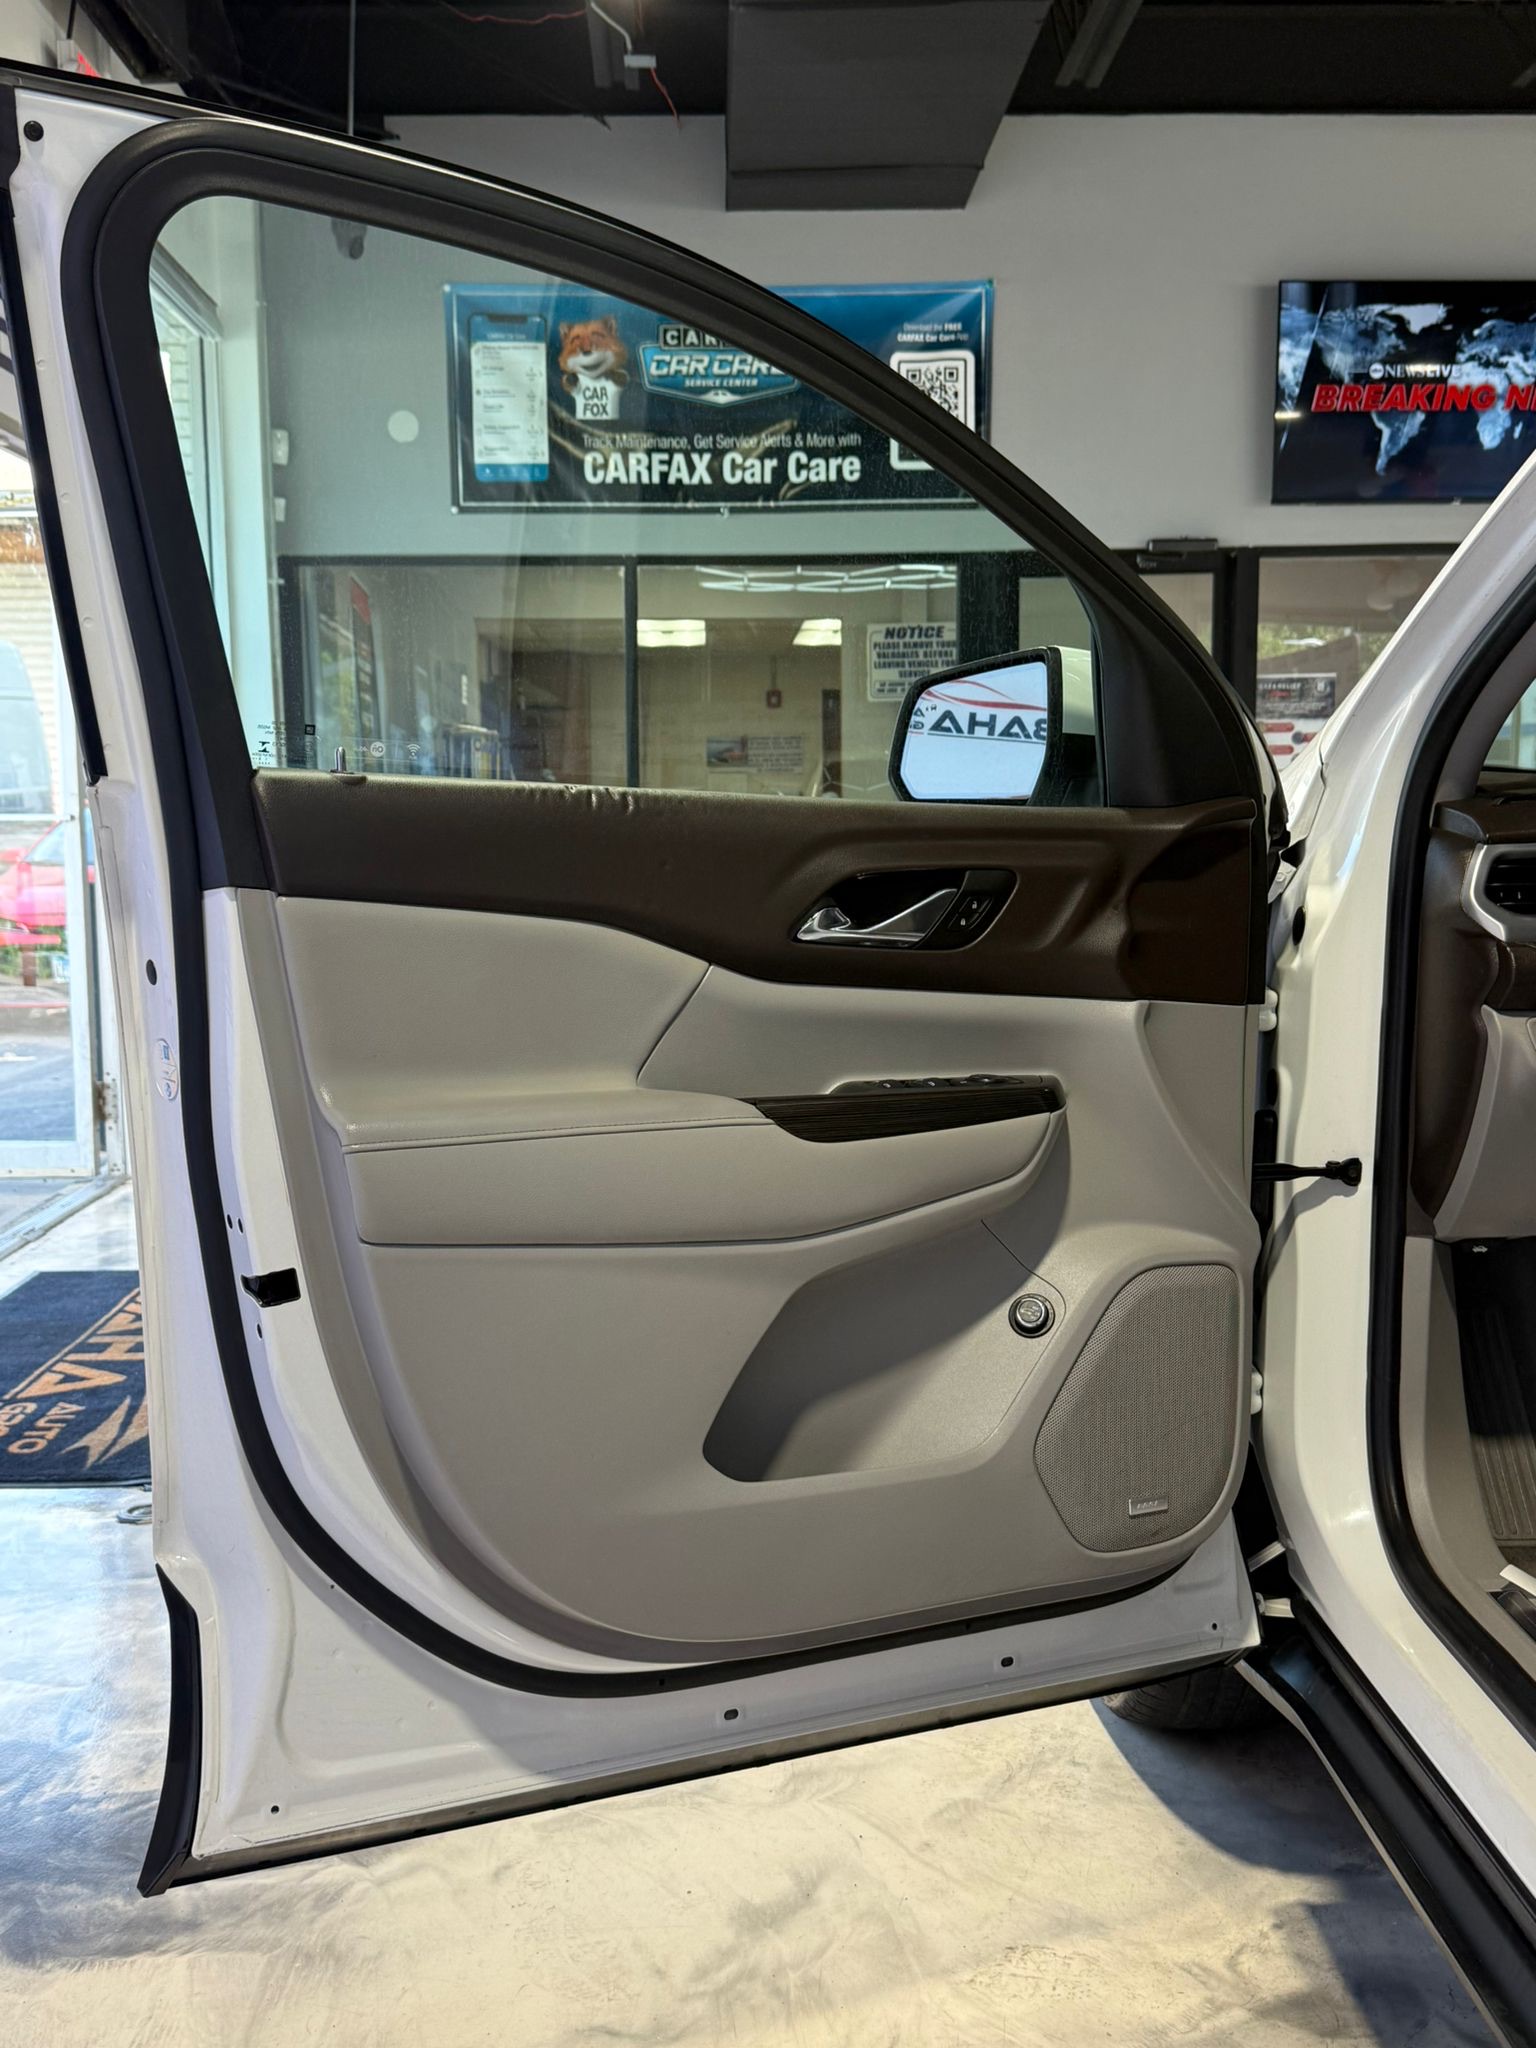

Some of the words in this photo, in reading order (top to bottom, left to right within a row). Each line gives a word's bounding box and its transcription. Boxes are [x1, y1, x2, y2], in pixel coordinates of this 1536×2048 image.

[665, 329, 733, 346] CAR
[650, 354, 710, 376] CAR
[684, 378, 721, 388] SERVICE
[723, 378, 758, 388] CENTER
[582, 386, 609, 401] CAR
[1311, 384, 1496, 412] BREAKING
[1503, 384, 1536, 412] N
[583, 402, 609, 417] FOX
[582, 433, 612, 449] Track
[616, 433, 691, 450] Maintenance,
[693, 433, 713, 449] Get
[715, 433, 757, 449] Service
[761, 433, 792, 448] Alerts
[794, 433, 804, 448] &
[806, 432, 835, 448] More
[838, 432, 862, 447] with
[583, 451, 713, 485] CARFAX
[722, 450, 778, 485] Car
[787, 450, 861, 484] Care
[884, 625, 945, 640] NOTICE
[8, 1401, 86, 1454] AUTO
